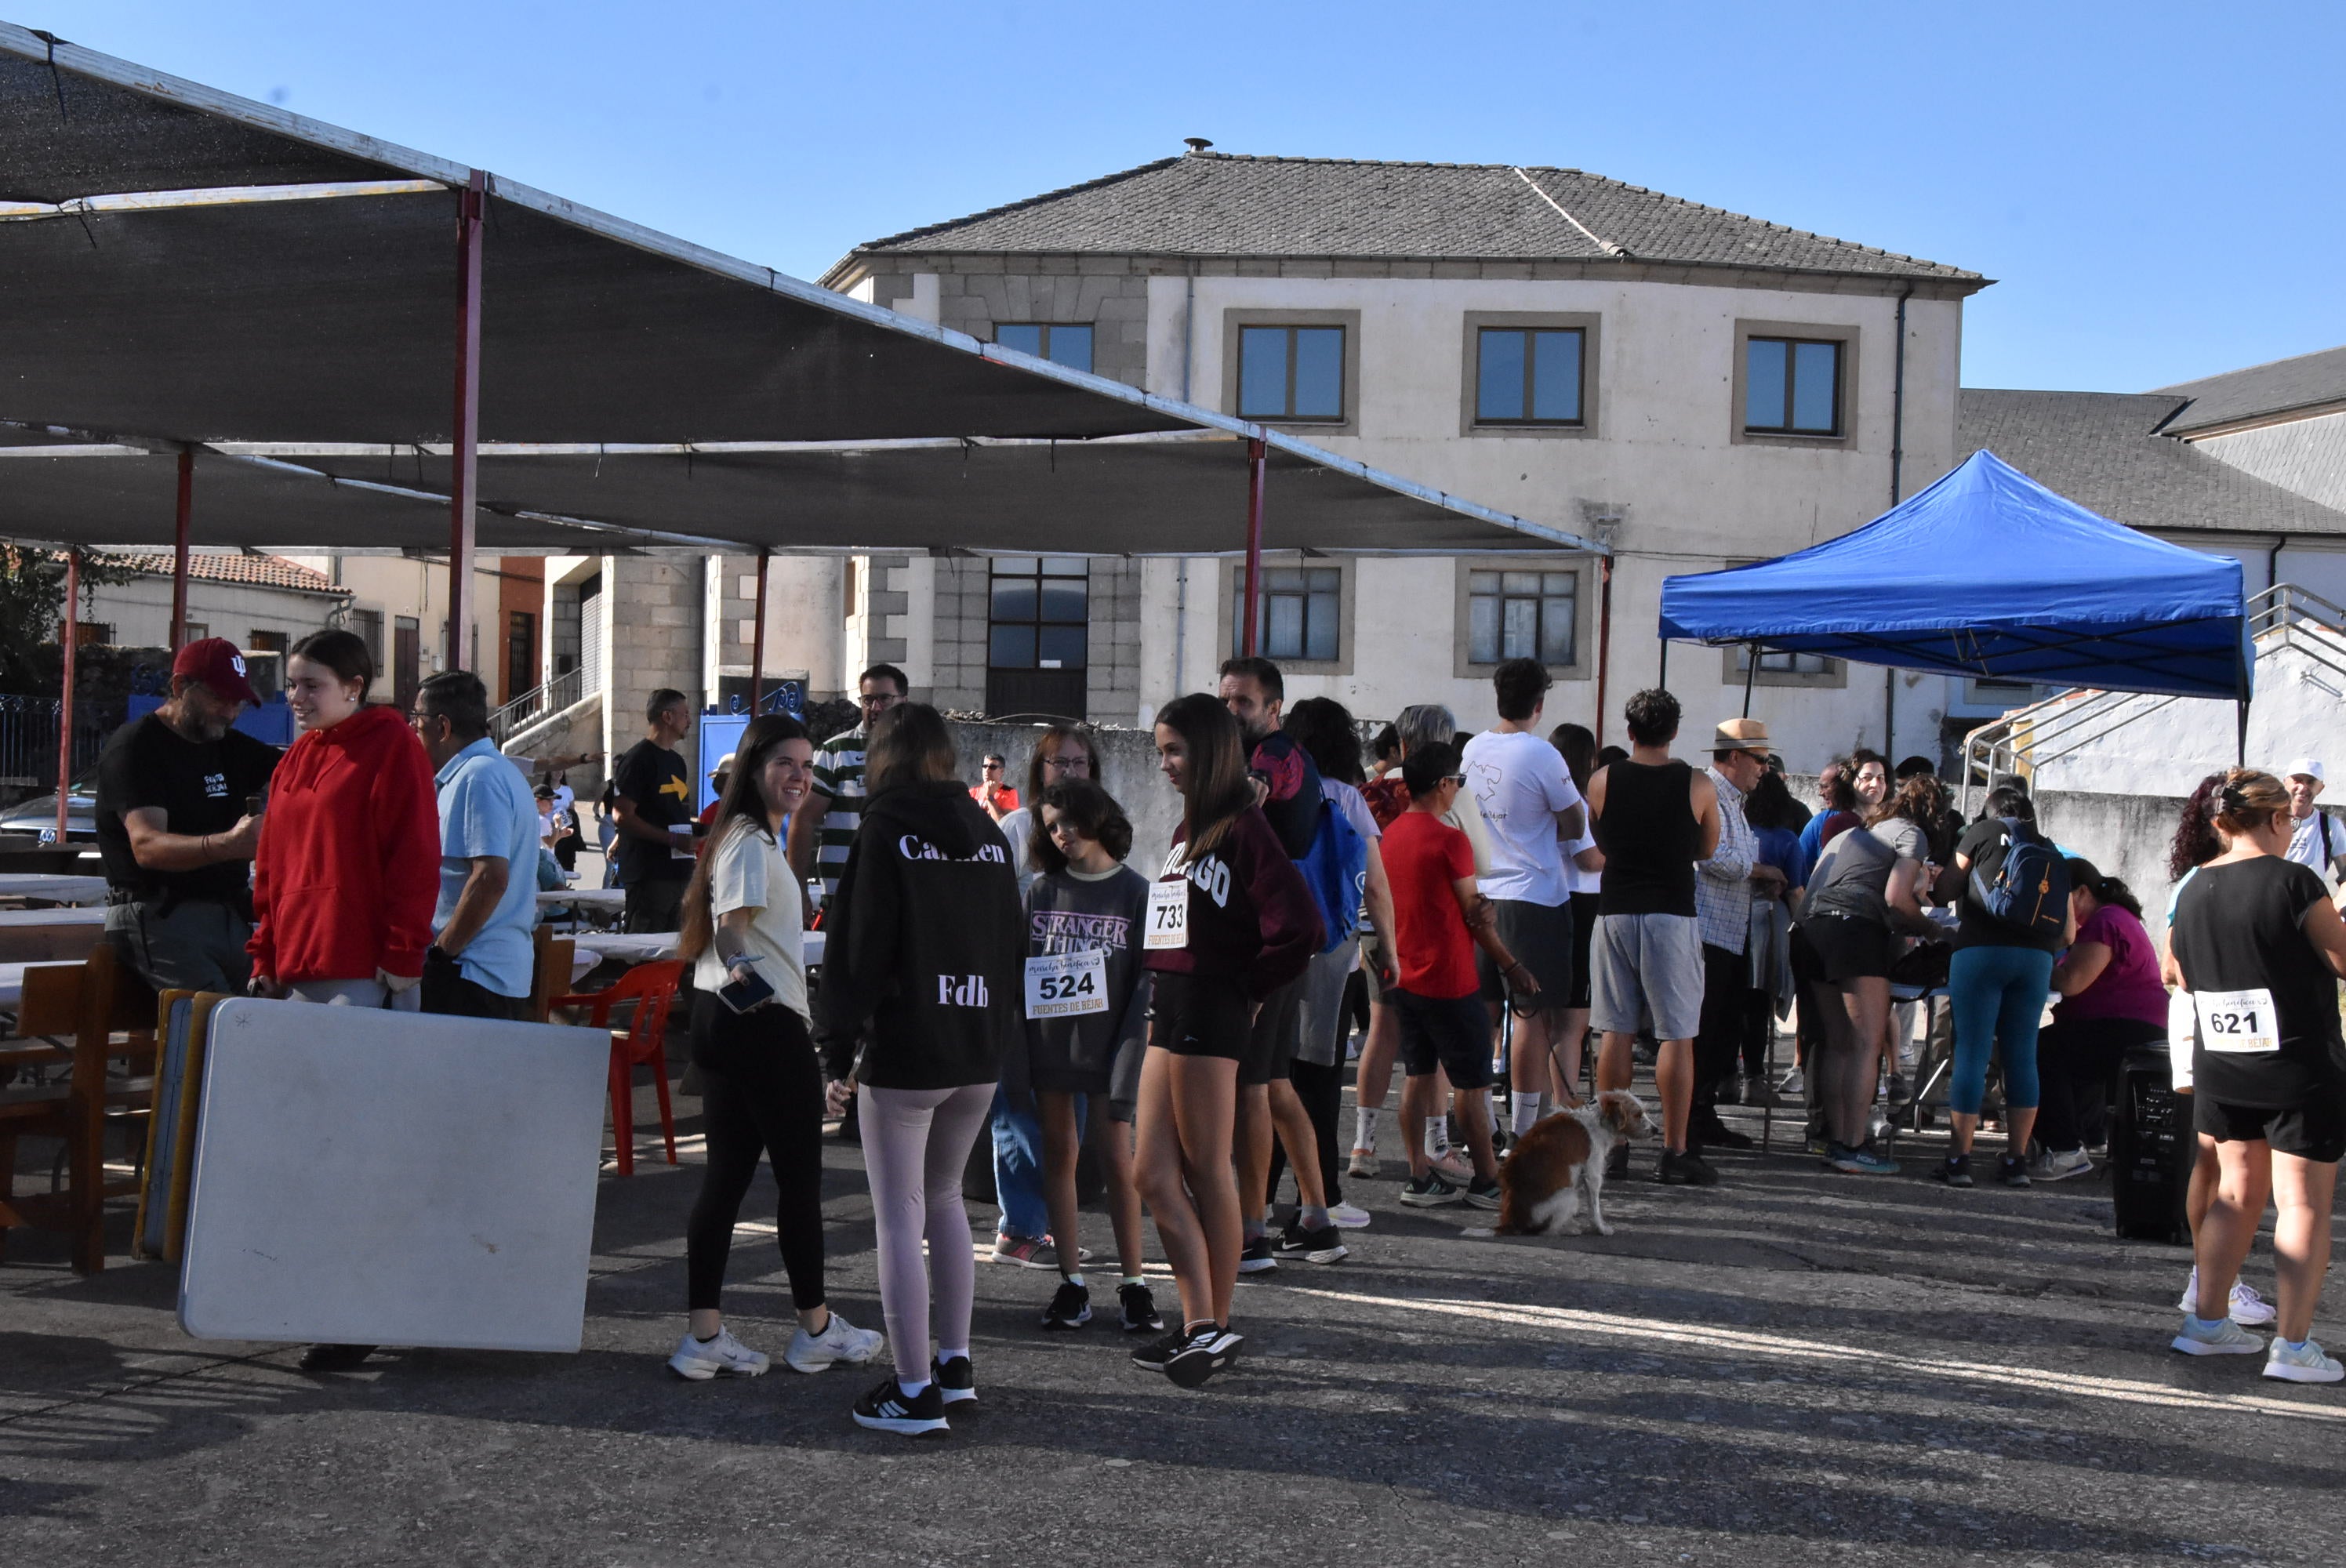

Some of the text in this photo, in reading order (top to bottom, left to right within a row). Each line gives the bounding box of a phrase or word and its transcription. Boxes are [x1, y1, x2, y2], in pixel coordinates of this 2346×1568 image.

[899, 835, 1006, 863] Caen
[1157, 903, 1183, 929] 733
[1032, 913, 1129, 946] STRANGER
[1042, 935, 1113, 957] THINGS
[1029, 962, 1059, 974] marcha
[1040, 971, 1095, 1000] 524
[1033, 997, 1103, 1015] FUENTES DE BÉJAR
[2211, 1011, 2258, 1034] 621
[2248, 1036, 2272, 1048] BÉJAR
